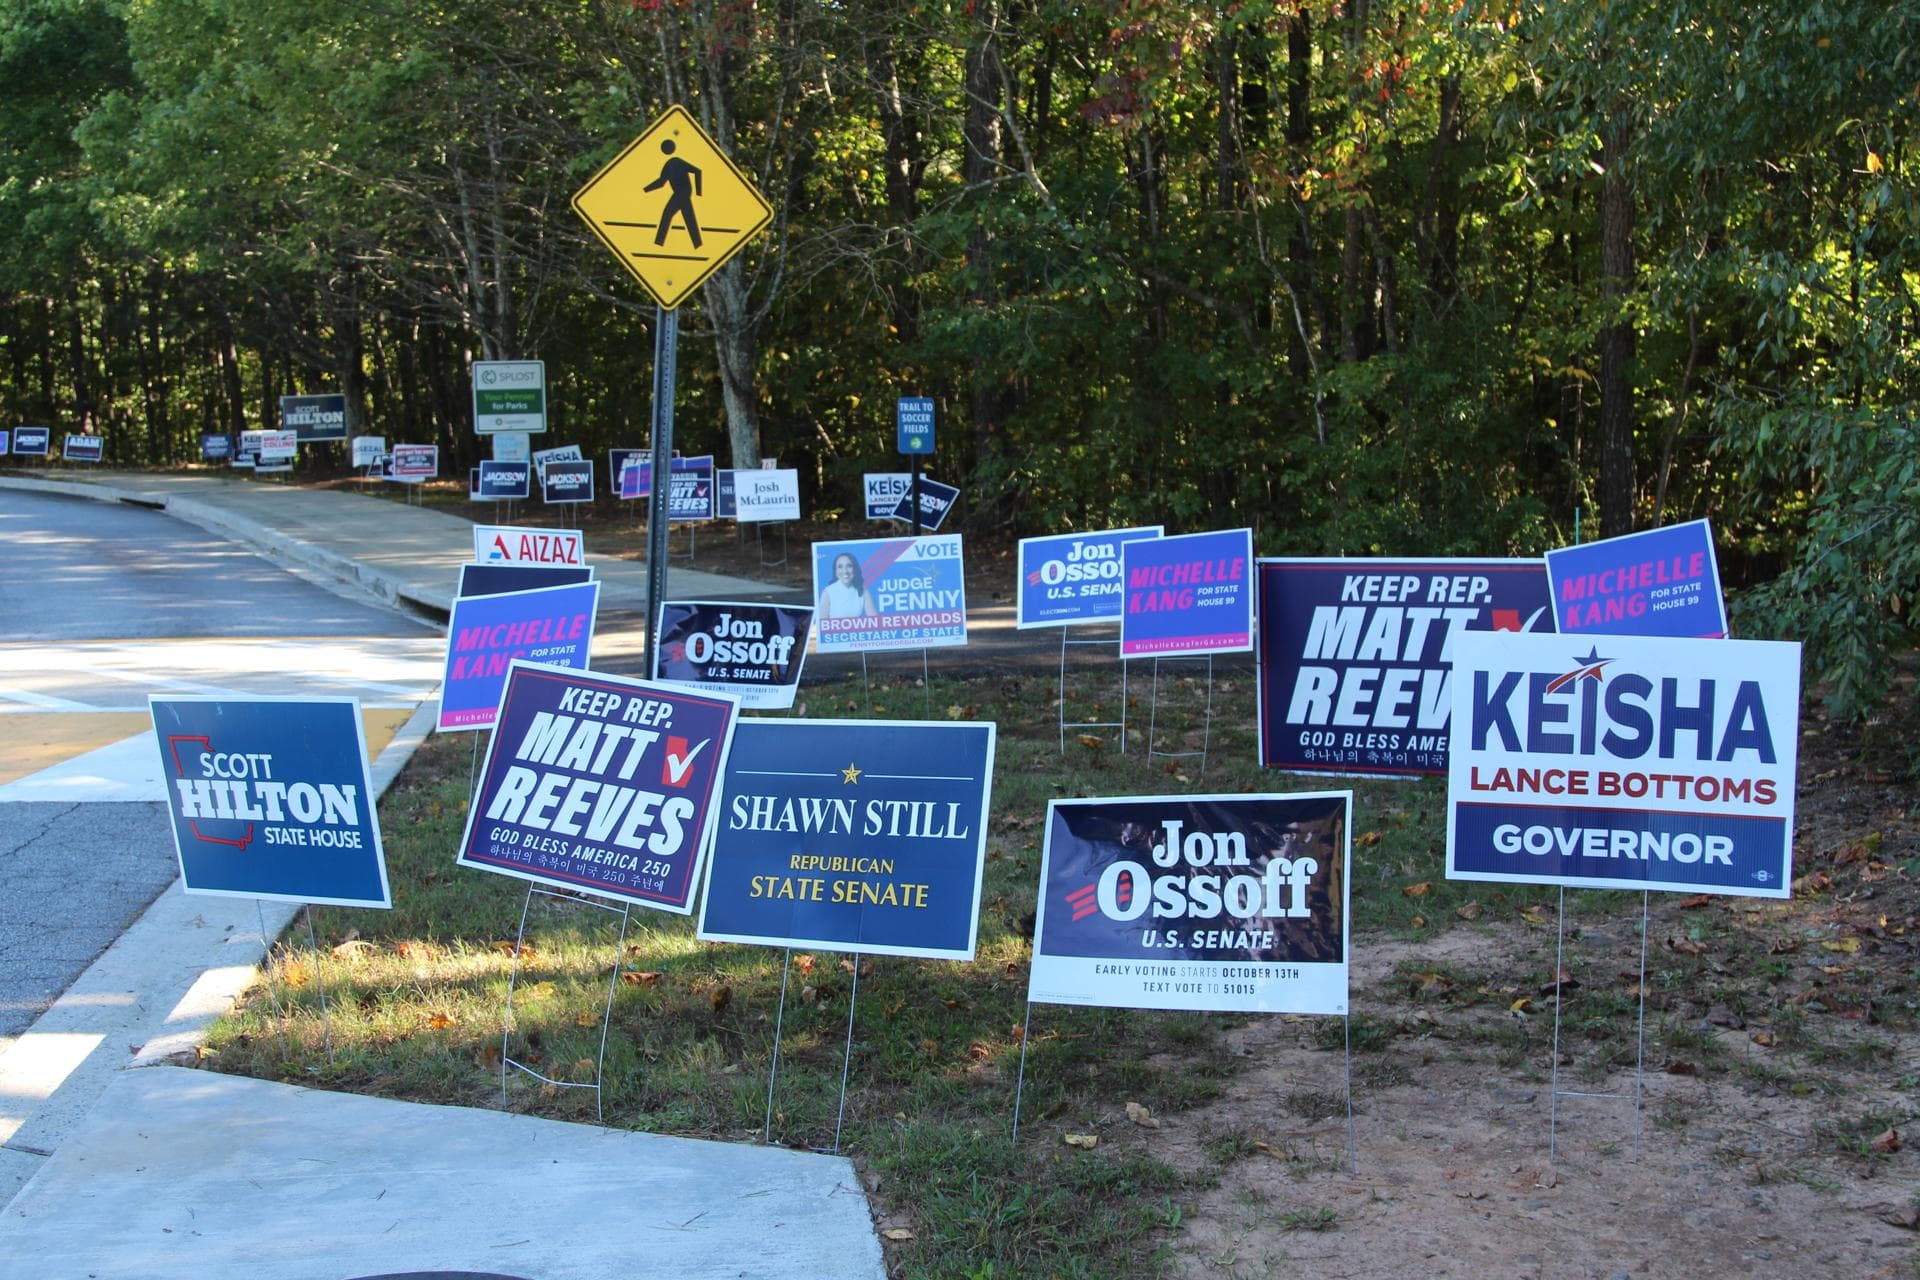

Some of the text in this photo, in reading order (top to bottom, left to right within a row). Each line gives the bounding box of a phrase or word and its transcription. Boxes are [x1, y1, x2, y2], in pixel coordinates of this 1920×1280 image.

[506, 401, 528, 410] Parks
[900, 402, 933, 412] TRAIL TO
[286, 411, 343, 425] HILTON
[902, 414, 931, 422] SOCCER
[904, 424, 929, 433] FIELDS
[69, 437, 99, 447] ADAM
[483, 472, 526, 482] JACKSON
[547, 473, 589, 485] JACKSON
[754, 482, 779, 494] Josh
[740, 494, 795, 506] McLaurin
[519, 534, 578, 564] AIZAZ
[915, 543, 958, 557] VOTE
[1067, 541, 1115, 562] Jon
[1040, 559, 1122, 585] Osso
[1129, 557, 1245, 589] MICHELLE
[1562, 552, 1705, 601] MICHELLE
[877, 577, 933, 592] JUDGE
[1047, 582, 1122, 600] U.S. SENA
[1197, 585, 1238, 596] FOR STATE
[1341, 575, 1492, 603] KEEP REP.
[1651, 582, 1702, 599] FOR STATE
[878, 589, 960, 612] PENNY
[1129, 589, 1194, 615] KANG
[1197, 597, 1235, 607] HOUSE 99
[1653, 596, 1699, 611] HOUSE 99
[820, 612, 962, 631] BROWN REYNOLDS
[1565, 595, 1648, 629] KANG
[455, 614, 587, 652] MICHELLE
[713, 613, 763, 639] Jon
[824, 626, 960, 643] SECRETARY OF STATE
[1302, 606, 1479, 662] MATT
[531, 645, 577, 657] FOR STATE
[684, 631, 795, 666] Ossoff
[1136, 638, 1234, 650] MichelleKangforGA.com
[708, 667, 771, 680] U.S. SENATE
[558, 687, 673, 729] KEEP REP.
[1286, 666, 1453, 730] REEV
[1471, 668, 1778, 764] KEISHA
[515, 711, 660, 781] MATT
[1299, 731, 1335, 747] GOD
[1343, 733, 1400, 750] BLESS
[199, 752, 273, 779] SCOTT
[1304, 748, 1358, 763] 하나님의
[1470, 767, 1778, 805] LANCE BOTTOMS
[176, 778, 359, 826] HILTON
[485, 765, 695, 856] REEVES
[730, 794, 969, 840] SHAWN STILL
[264, 826, 363, 849] STATE HOUSE
[1152, 819, 1250, 868] Jon
[1492, 824, 1734, 866] GOVERNOR
[490, 827, 671, 878] GOD BLESS AMERICA 250
[490, 844, 532, 864] 하나님의
[576, 863, 599, 878] 미국
[603, 869, 625, 884] 250
[790, 854, 895, 874] REPUBLICAN
[750, 875, 929, 908] STATE SENATE
[1097, 857, 1318, 922] Ossoff
[1142, 929, 1273, 950] U.S. SENATE
[1095, 964, 1299, 979] EARLY VOTING STARTS OCTOBER 13TH
[1143, 983, 1255, 995] TEXT VOTE TO 51015
